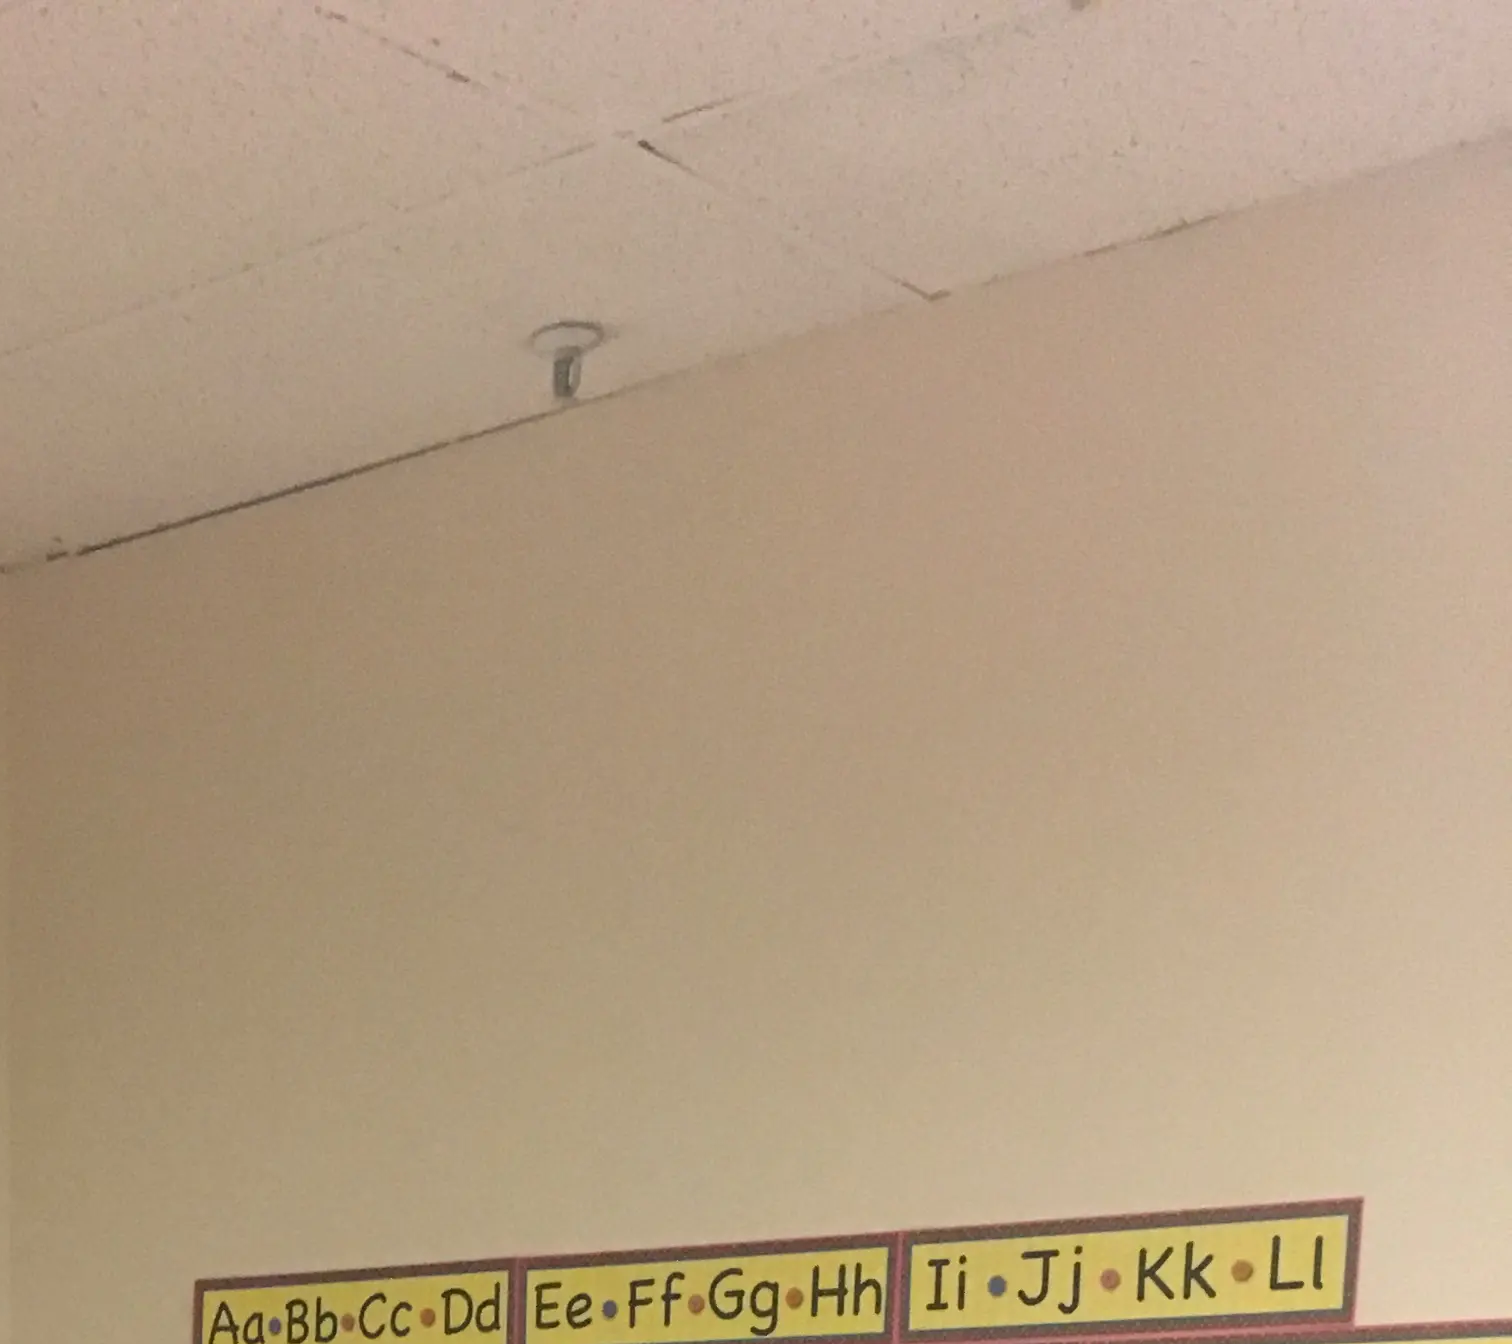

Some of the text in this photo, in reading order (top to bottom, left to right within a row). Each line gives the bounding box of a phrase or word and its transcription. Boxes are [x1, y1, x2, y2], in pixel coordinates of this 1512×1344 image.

[535, 1263, 882, 1337] Ee Ff Gg Hh
[926, 1235, 1324, 1314] Ii Jj Kk Ll
[285, 1297, 338, 1344] Bb
[358, 1292, 412, 1339] Cc
[441, 1287, 501, 1335] Dd
